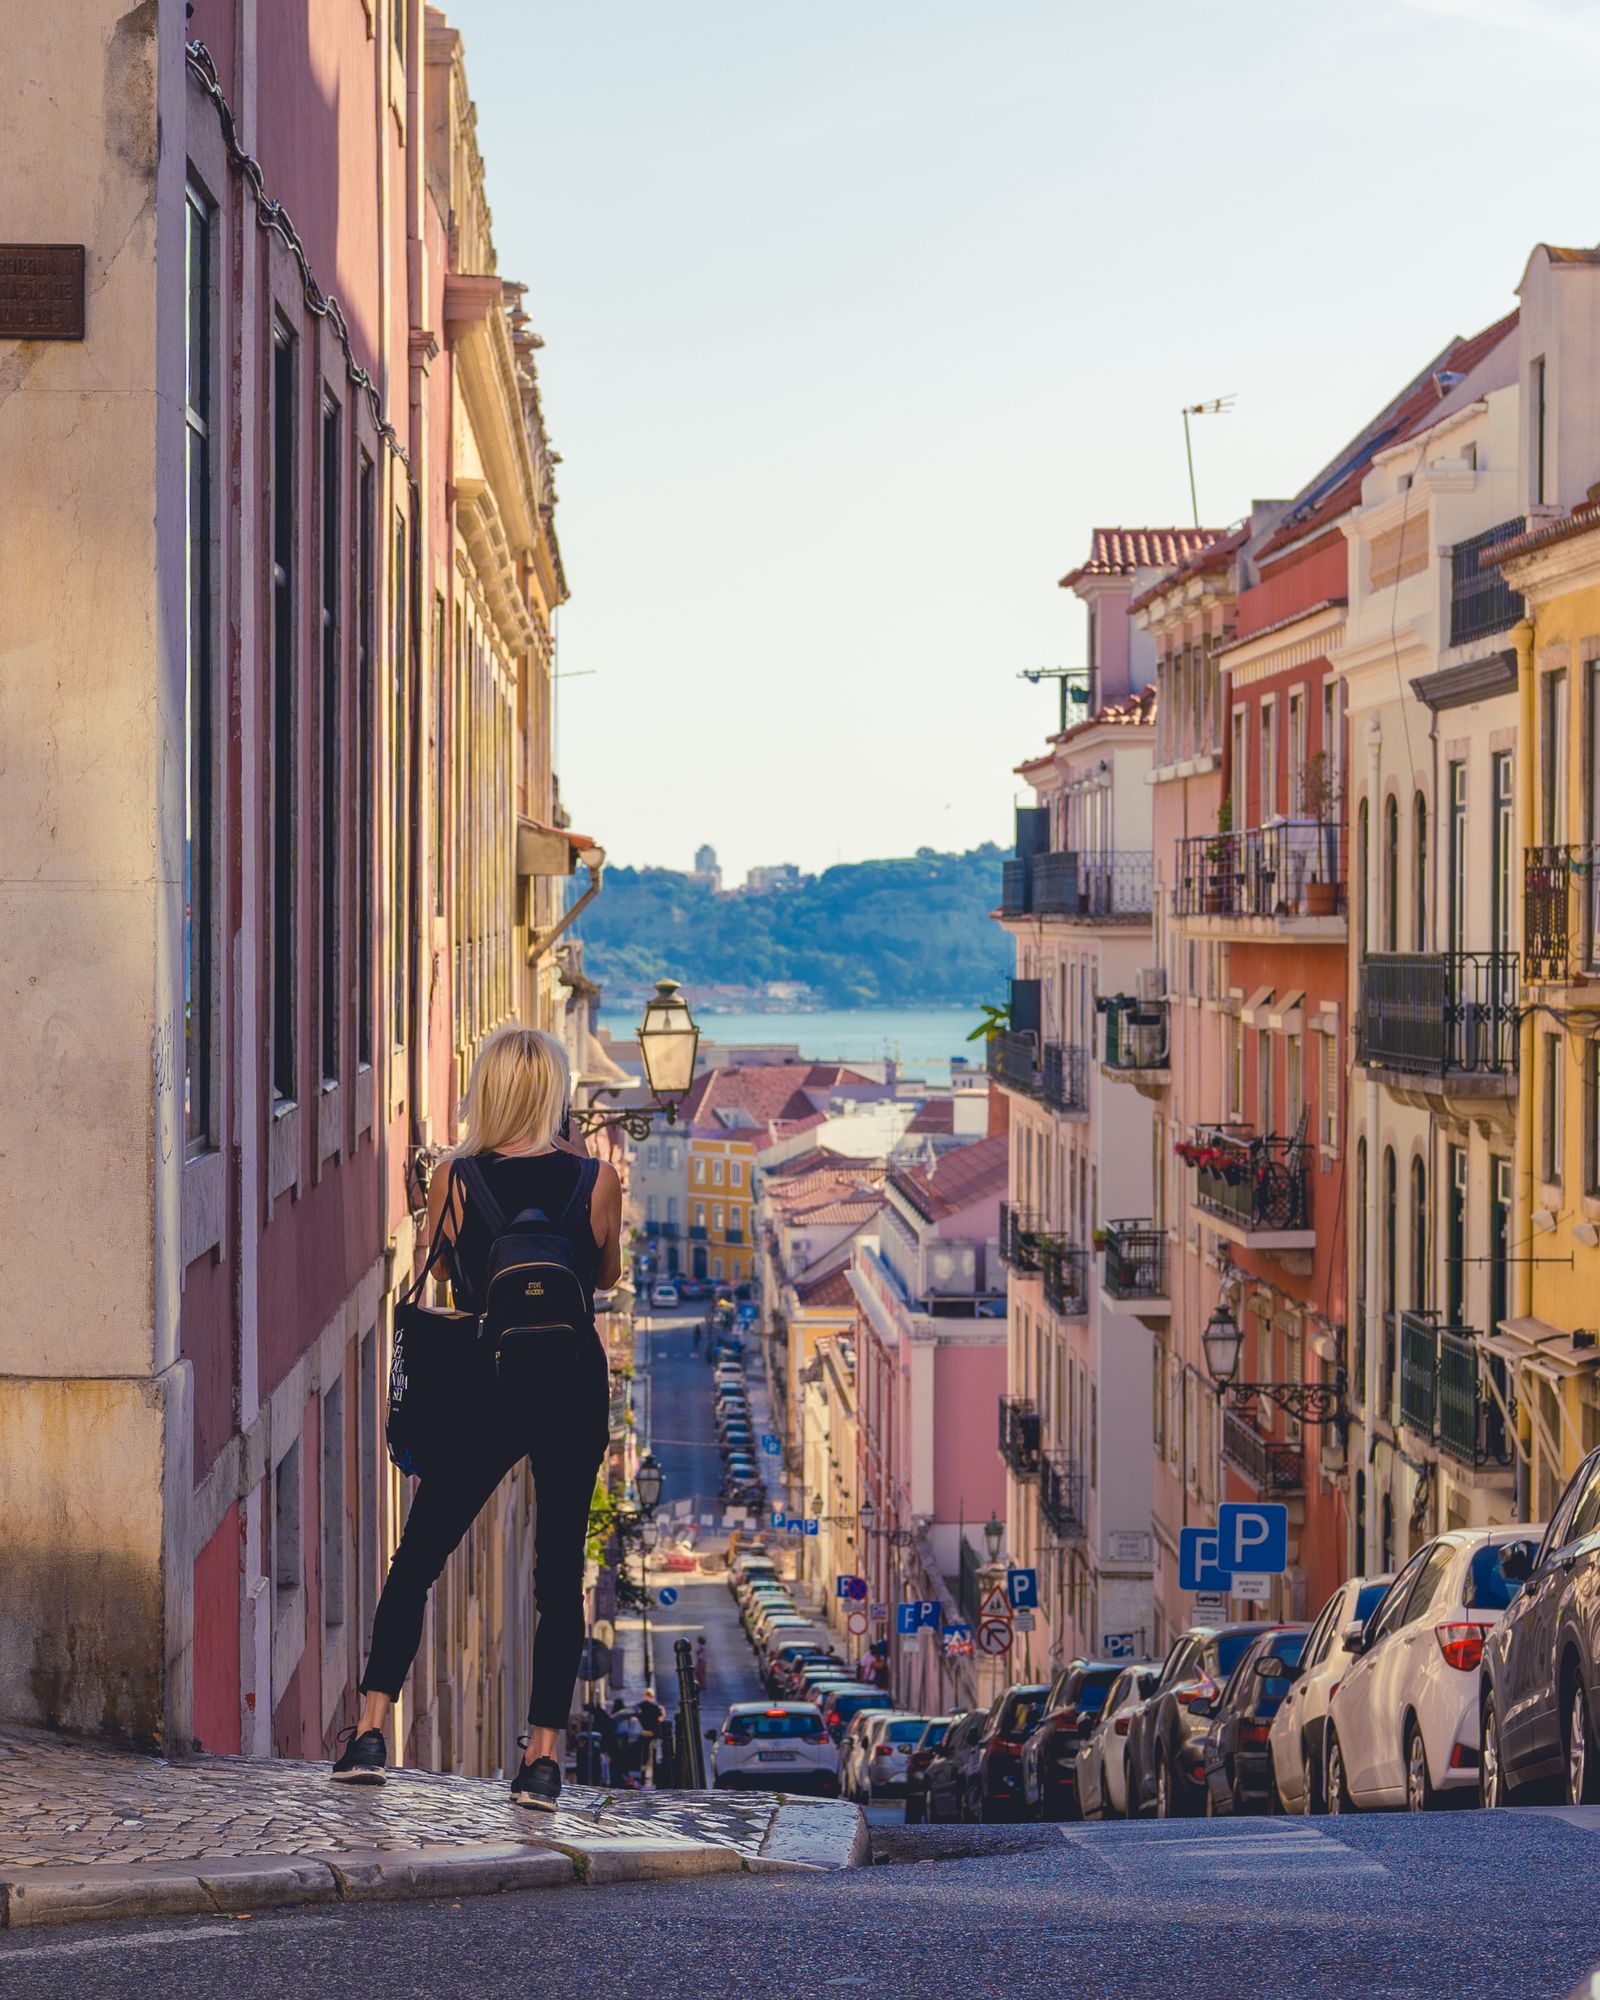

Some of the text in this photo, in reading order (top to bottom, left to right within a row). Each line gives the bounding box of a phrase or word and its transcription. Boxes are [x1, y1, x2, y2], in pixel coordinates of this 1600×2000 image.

[774, 1512, 783, 1528] P
[806, 1520, 817, 1534] P
[1235, 1513, 1269, 1563] P
[1013, 1575, 1030, 1603] P
[921, 1602, 933, 1619] P
